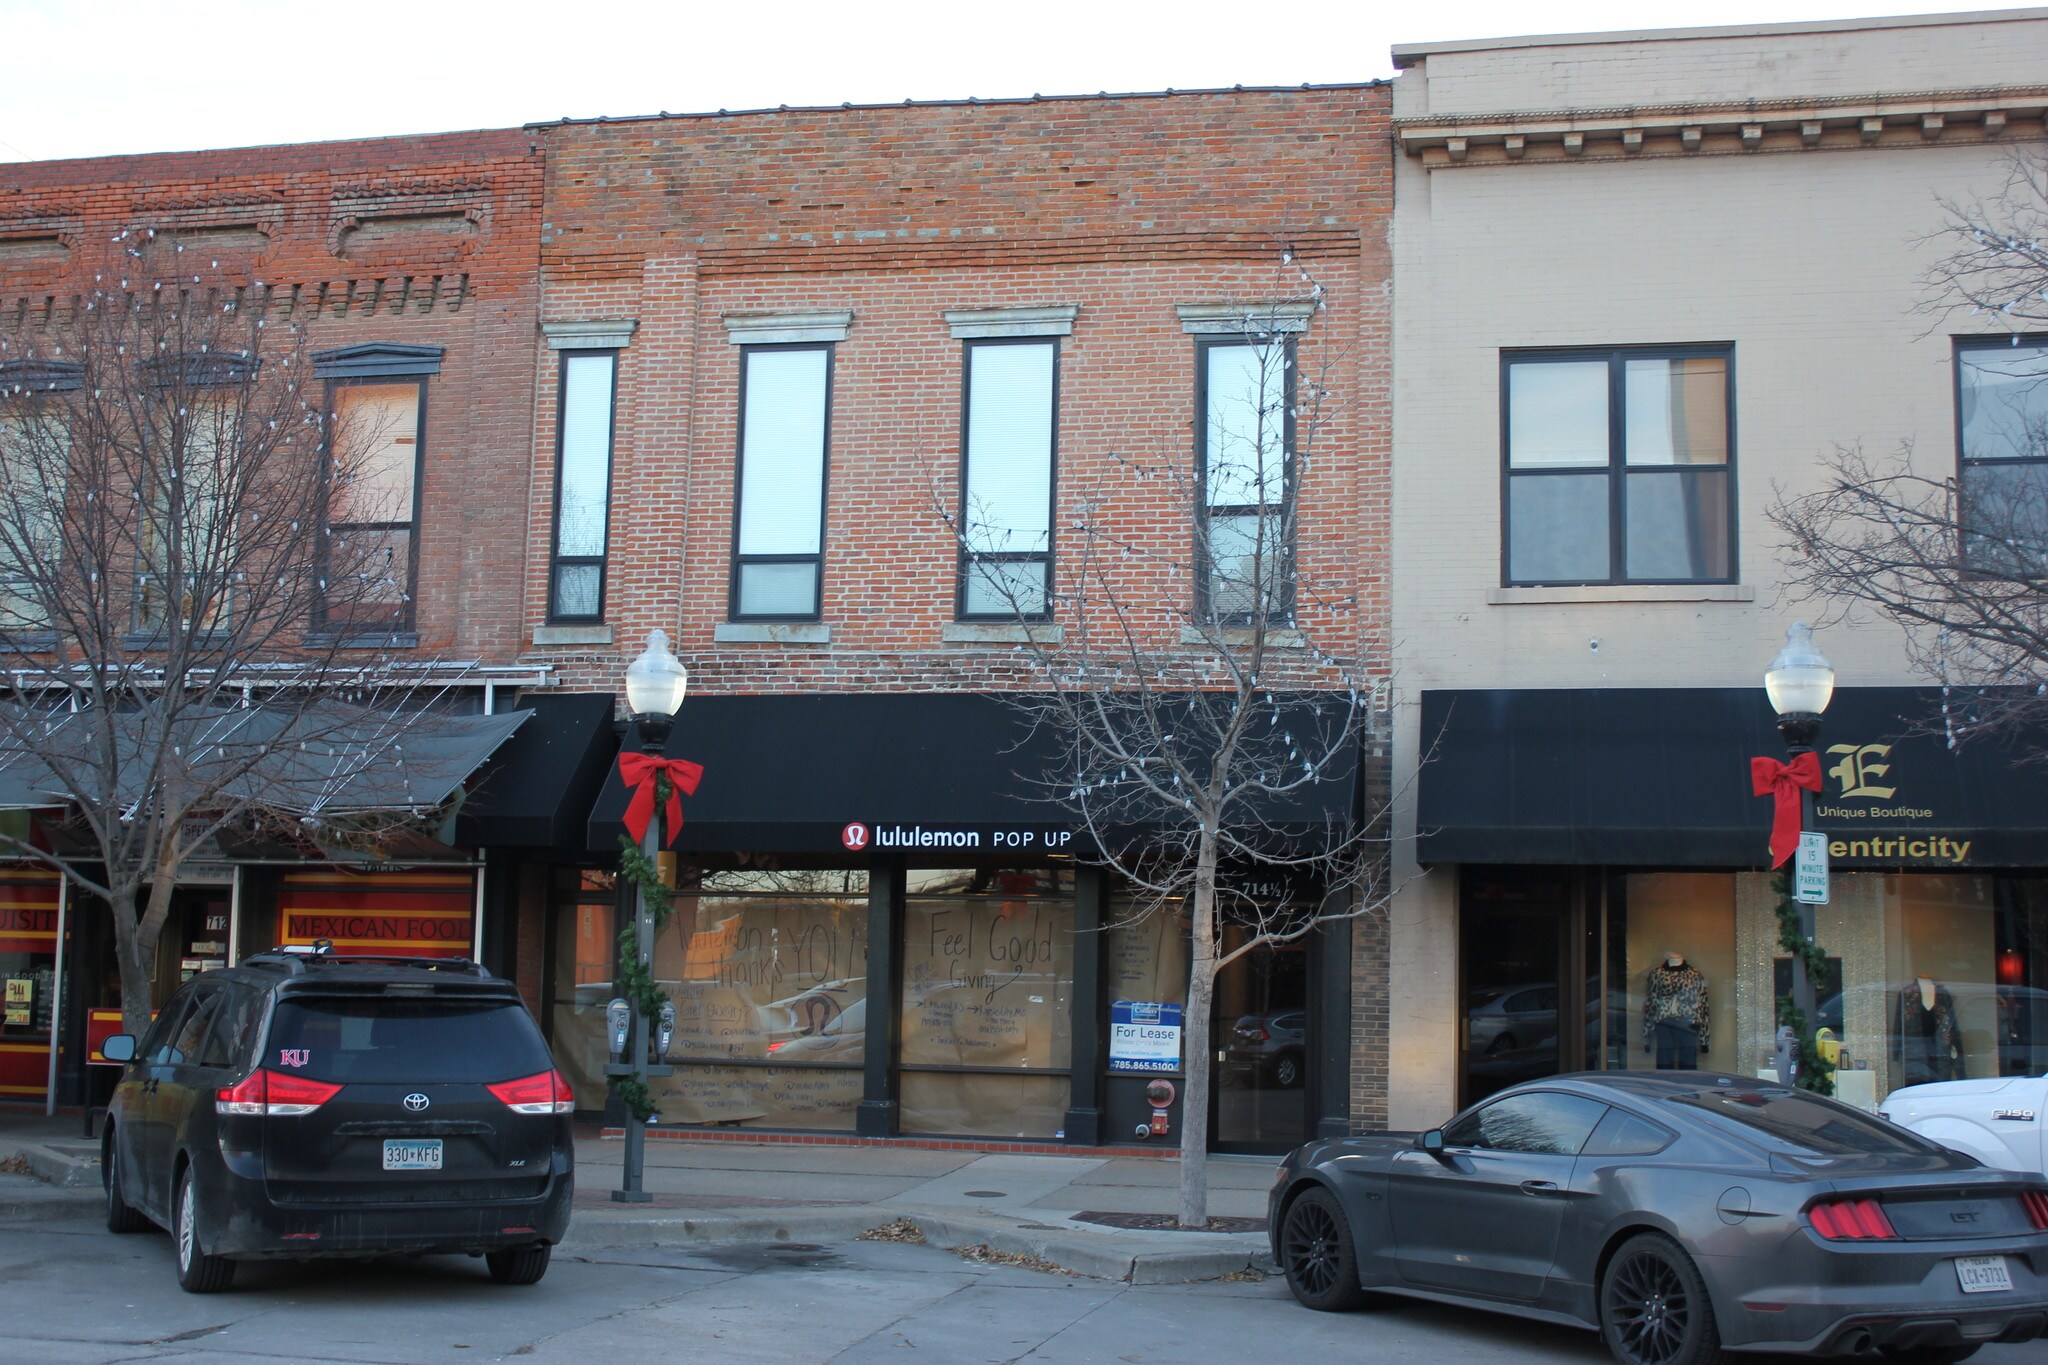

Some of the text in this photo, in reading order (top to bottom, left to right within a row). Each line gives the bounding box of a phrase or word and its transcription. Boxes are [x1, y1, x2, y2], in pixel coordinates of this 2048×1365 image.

[1817, 806, 1933, 819] Unique Boutique
[875, 825, 1072, 847] lululemon POP UP
[1768, 836, 1971, 863] entricity
[1804, 838, 1820, 848] LIMIT
[1808, 850, 1816, 861] 15
[1801, 864, 1823, 874] MINUTE
[1800, 876, 1826, 886] PARKING
[207, 916, 227, 928] 712
[290, 917, 472, 940] MEXICAN FOOD
[931, 911, 973, 958] Feel
[990, 904, 1053, 965] Good
[787, 923, 856, 990] YOU
[950, 960, 1019, 1004] Giving
[1116, 1026, 1175, 1040] For Lease
[279, 1049, 310, 1068] KU
[1114, 1060, 1174, 1071] 785.865.5100
[386, 1146, 439, 1162] 330 KFG
[1950, 1211, 1980, 1223] GT
[1969, 1257, 1990, 1266] TEXAS
